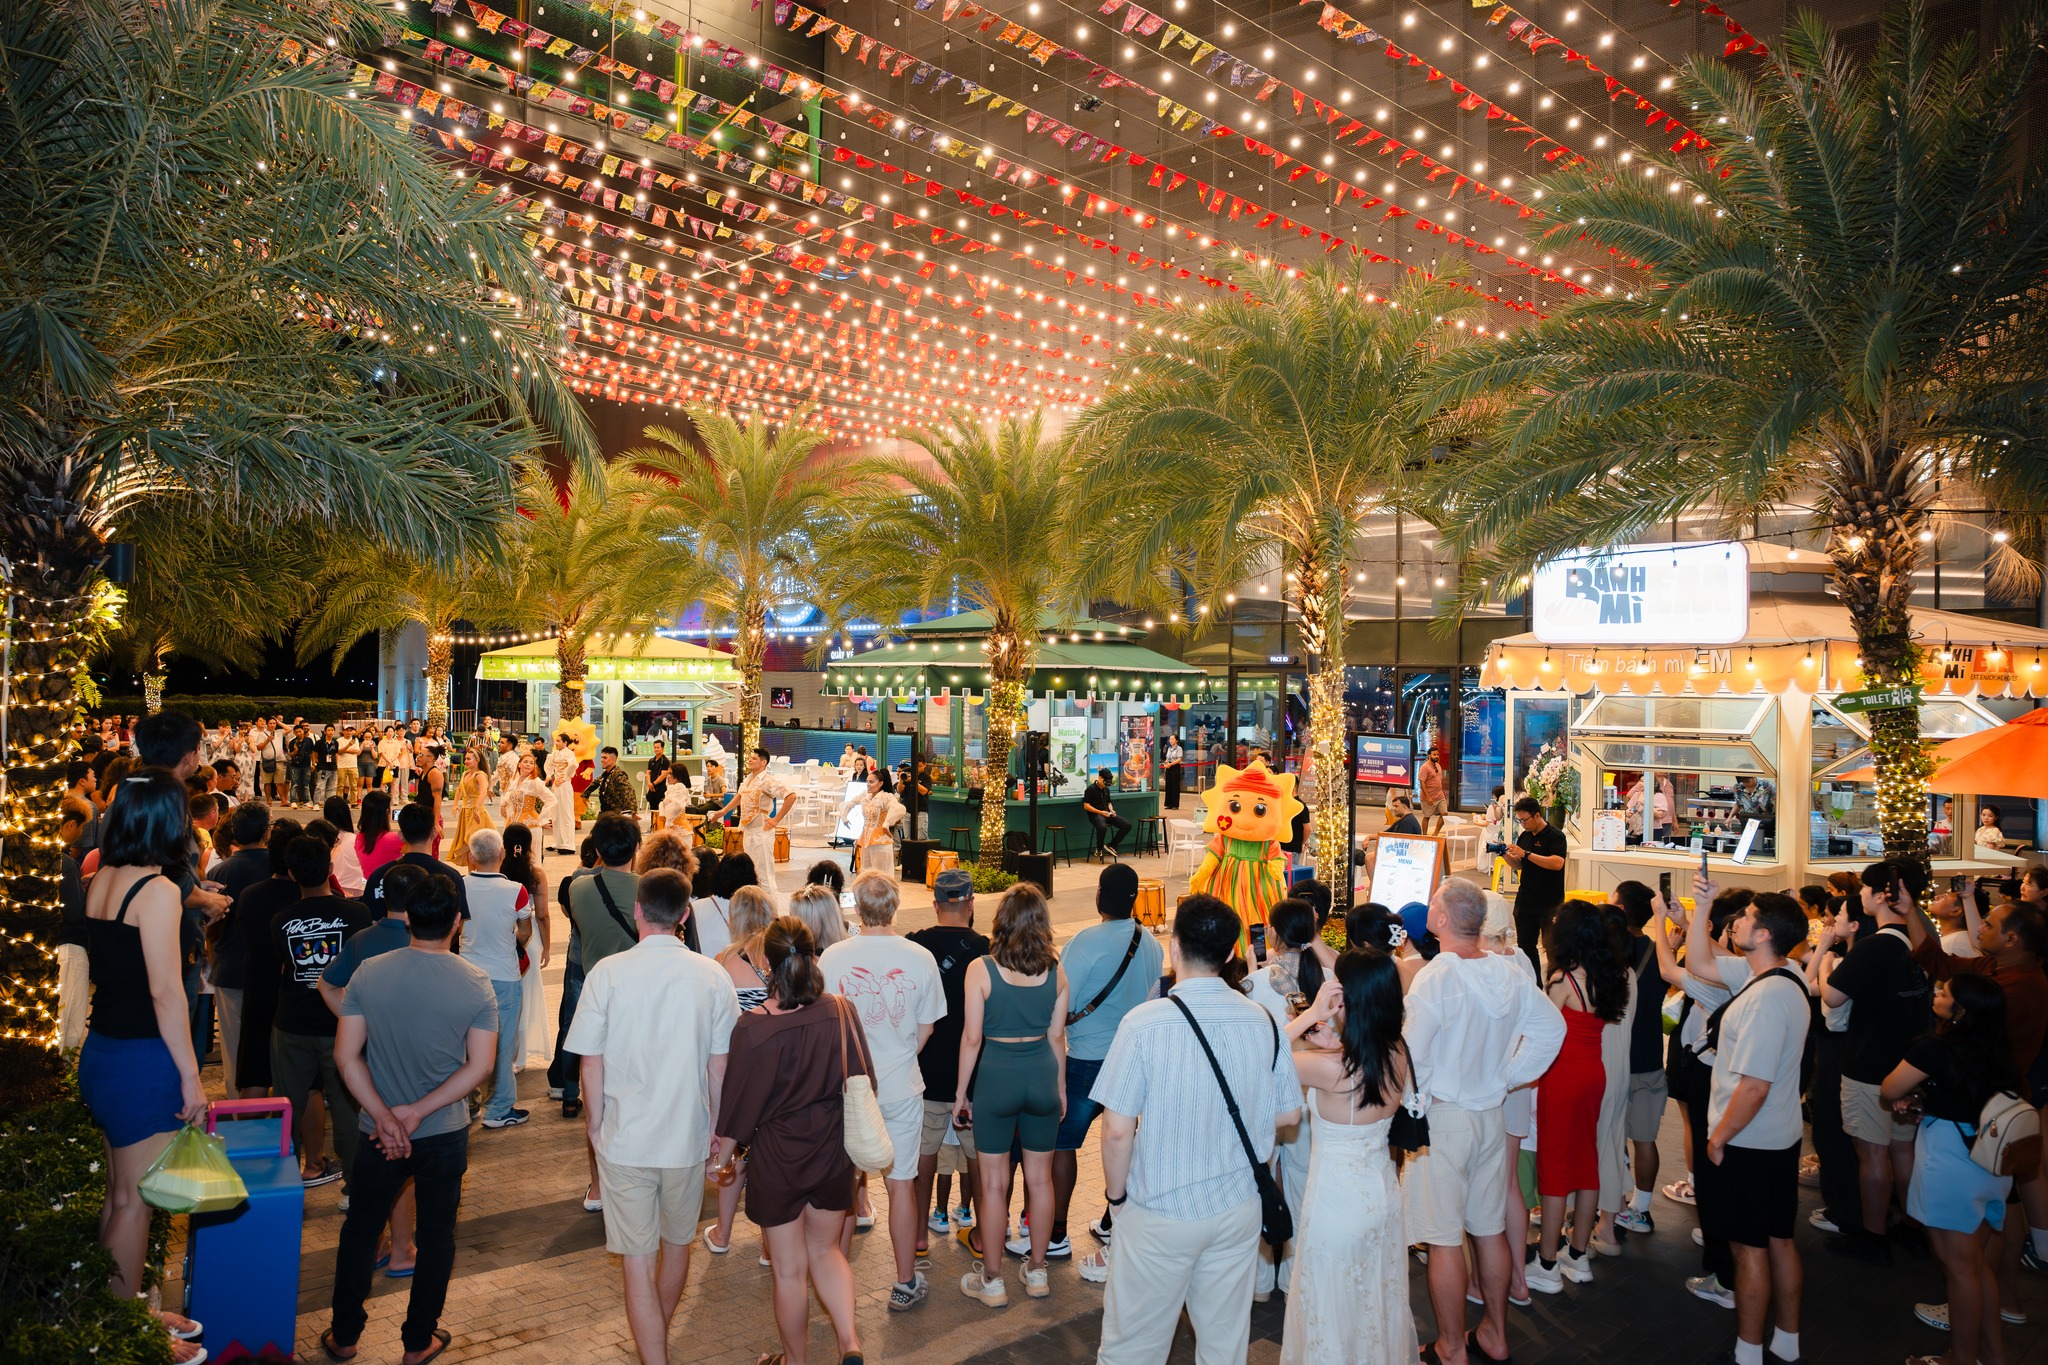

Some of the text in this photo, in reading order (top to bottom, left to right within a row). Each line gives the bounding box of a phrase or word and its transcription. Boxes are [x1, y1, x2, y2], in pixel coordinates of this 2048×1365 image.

[1599, 594, 1644, 624] Mì
[1665, 654, 1684, 673] mì
[1695, 649, 1732, 674] EM
[1860, 693, 1890, 706] TOILET
[1058, 728, 1080, 737] Matcha
